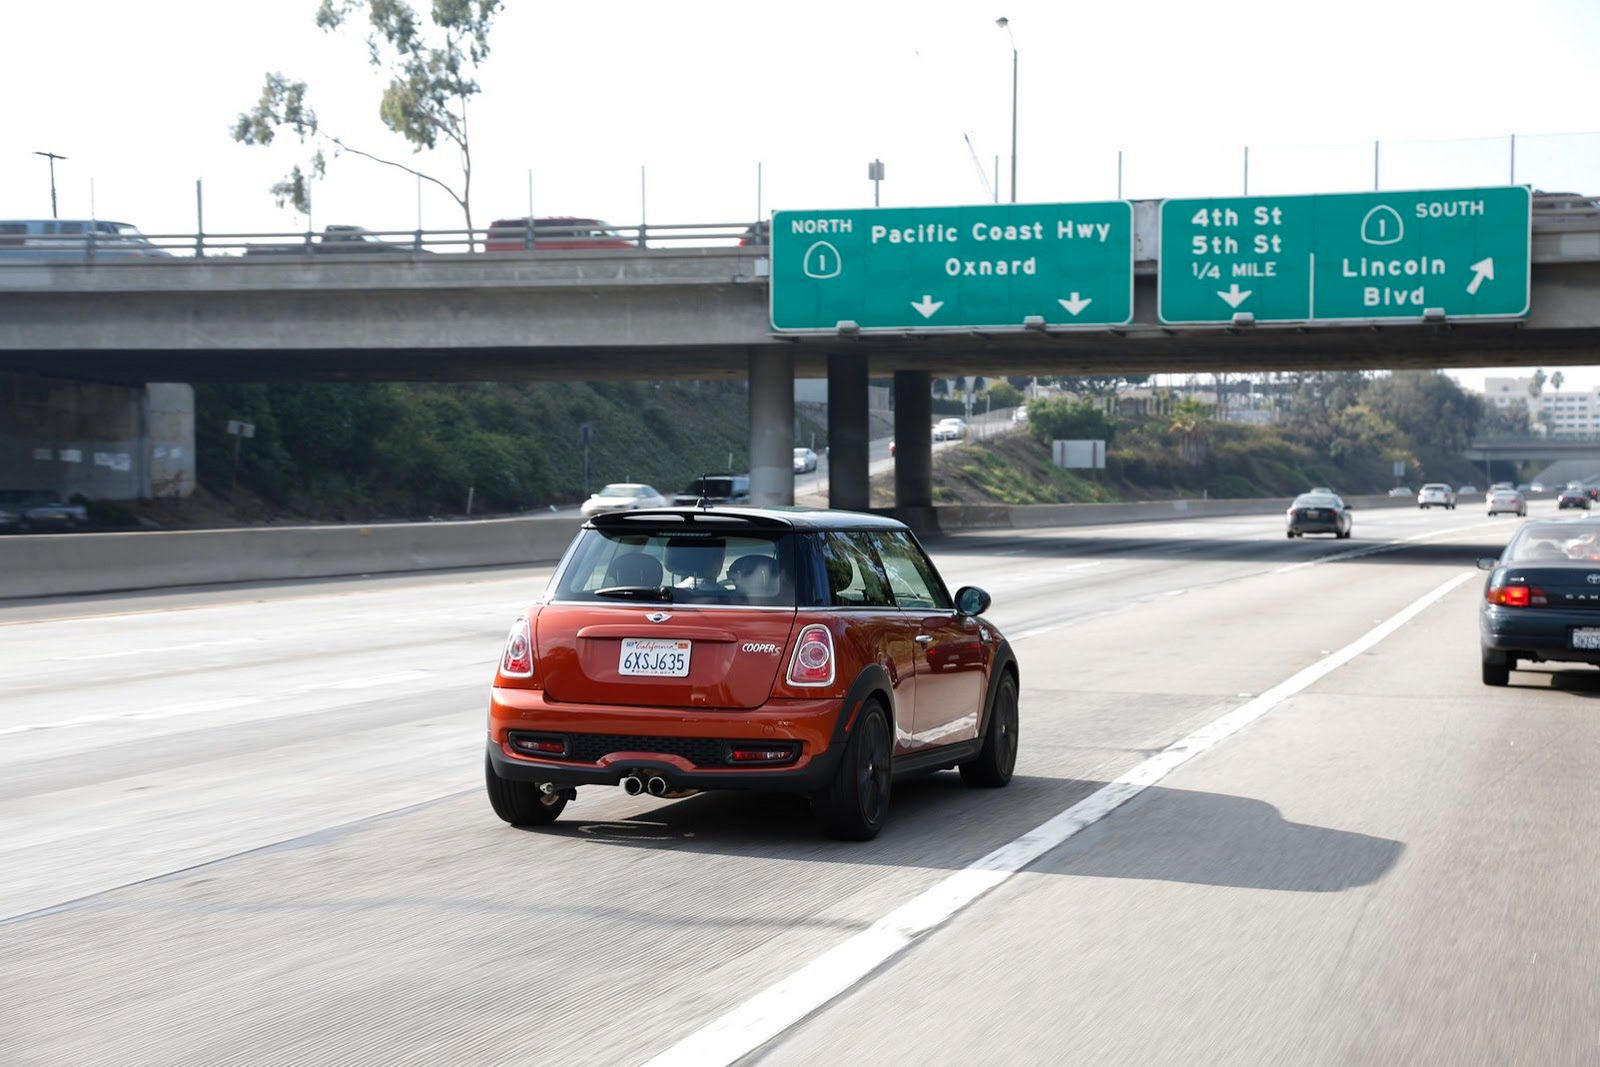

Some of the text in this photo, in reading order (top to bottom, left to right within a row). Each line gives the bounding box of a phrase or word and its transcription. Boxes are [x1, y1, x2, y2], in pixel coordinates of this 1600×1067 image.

[1191, 206, 1282, 227] 4th St
[1415, 201, 1485, 219] SOUTH
[792, 219, 852, 234] NORTH
[871, 220, 1111, 244] Pacific Coast Hwy
[1378, 219, 1386, 237] 1
[1191, 234, 1282, 255] 5th St
[818, 254, 826, 271] 1
[945, 257, 1036, 276] Oxnard
[1191, 261, 1277, 279] 1/4 MILE
[1342, 256, 1446, 278] Lincoln
[1363, 286, 1425, 306] Blvd
[635, 640, 675, 652] California
[742, 642, 776, 654] COOPER
[624, 652, 685, 671] 6XSJ635
